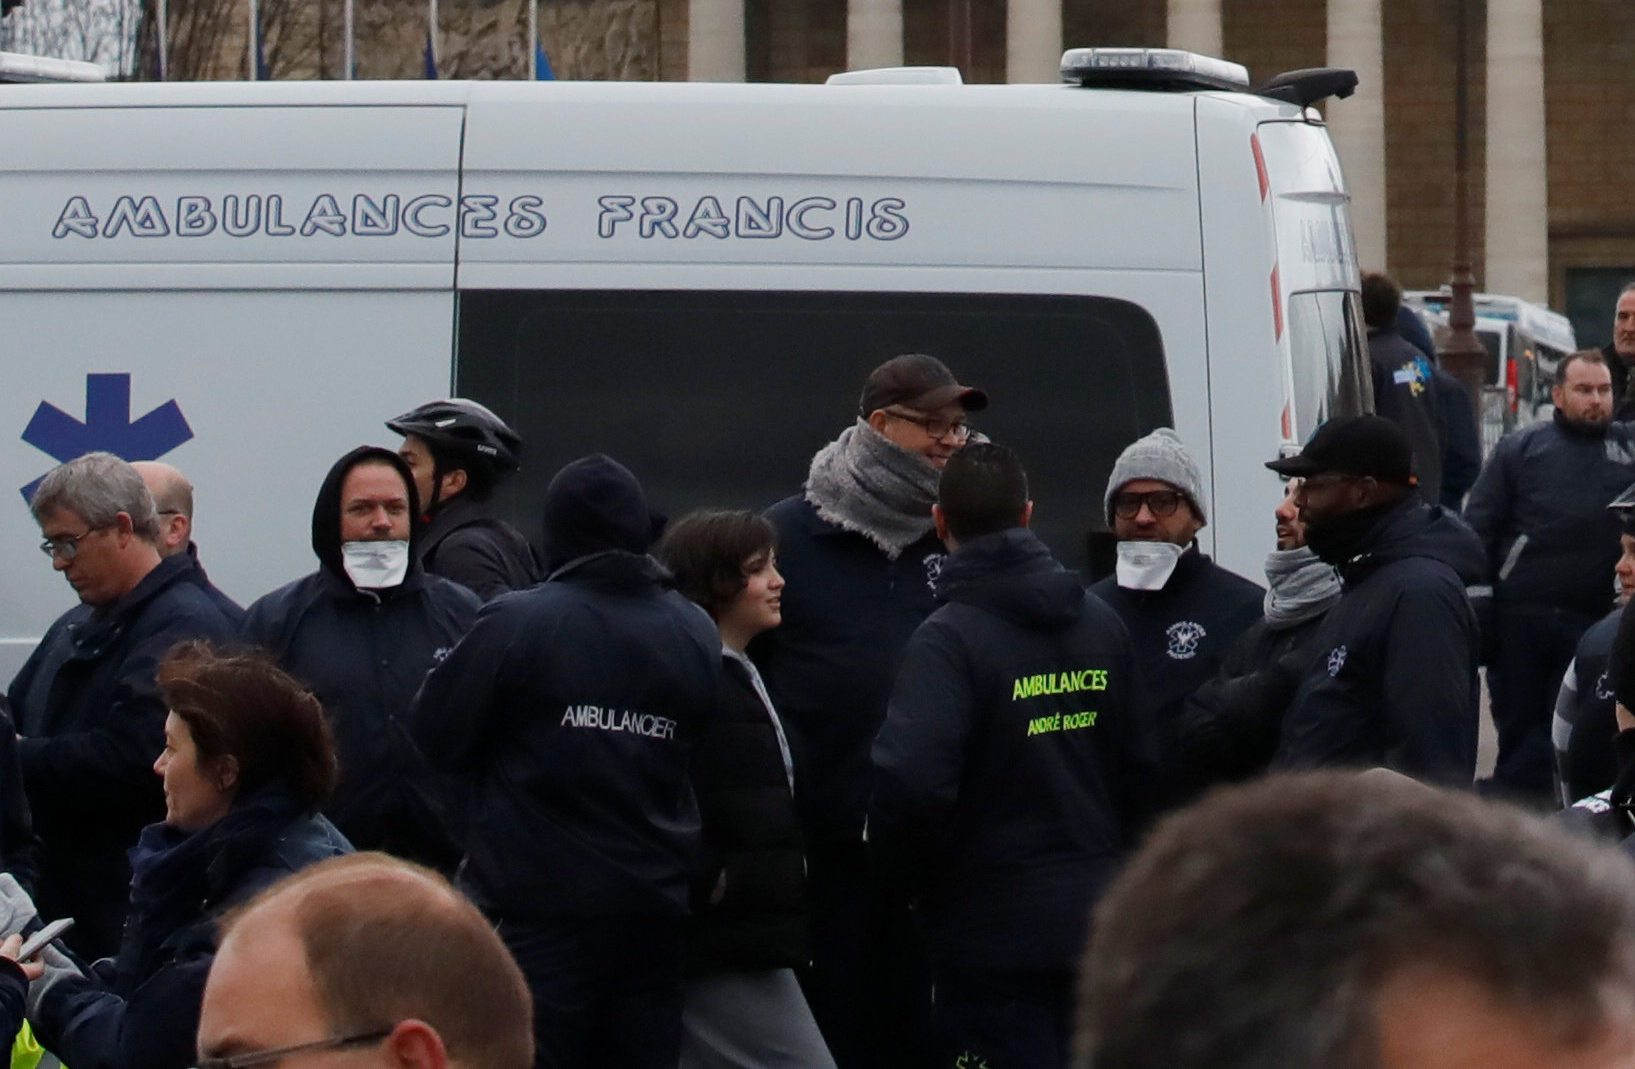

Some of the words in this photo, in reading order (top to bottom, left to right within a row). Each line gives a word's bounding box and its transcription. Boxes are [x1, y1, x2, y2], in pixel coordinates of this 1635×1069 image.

[53, 195, 546, 238] AMBULANCES
[598, 196, 909, 240] FRANCIS
[1012, 669, 1108, 701] AMBULANCES
[1027, 712, 1060, 737] ANDRÉ
